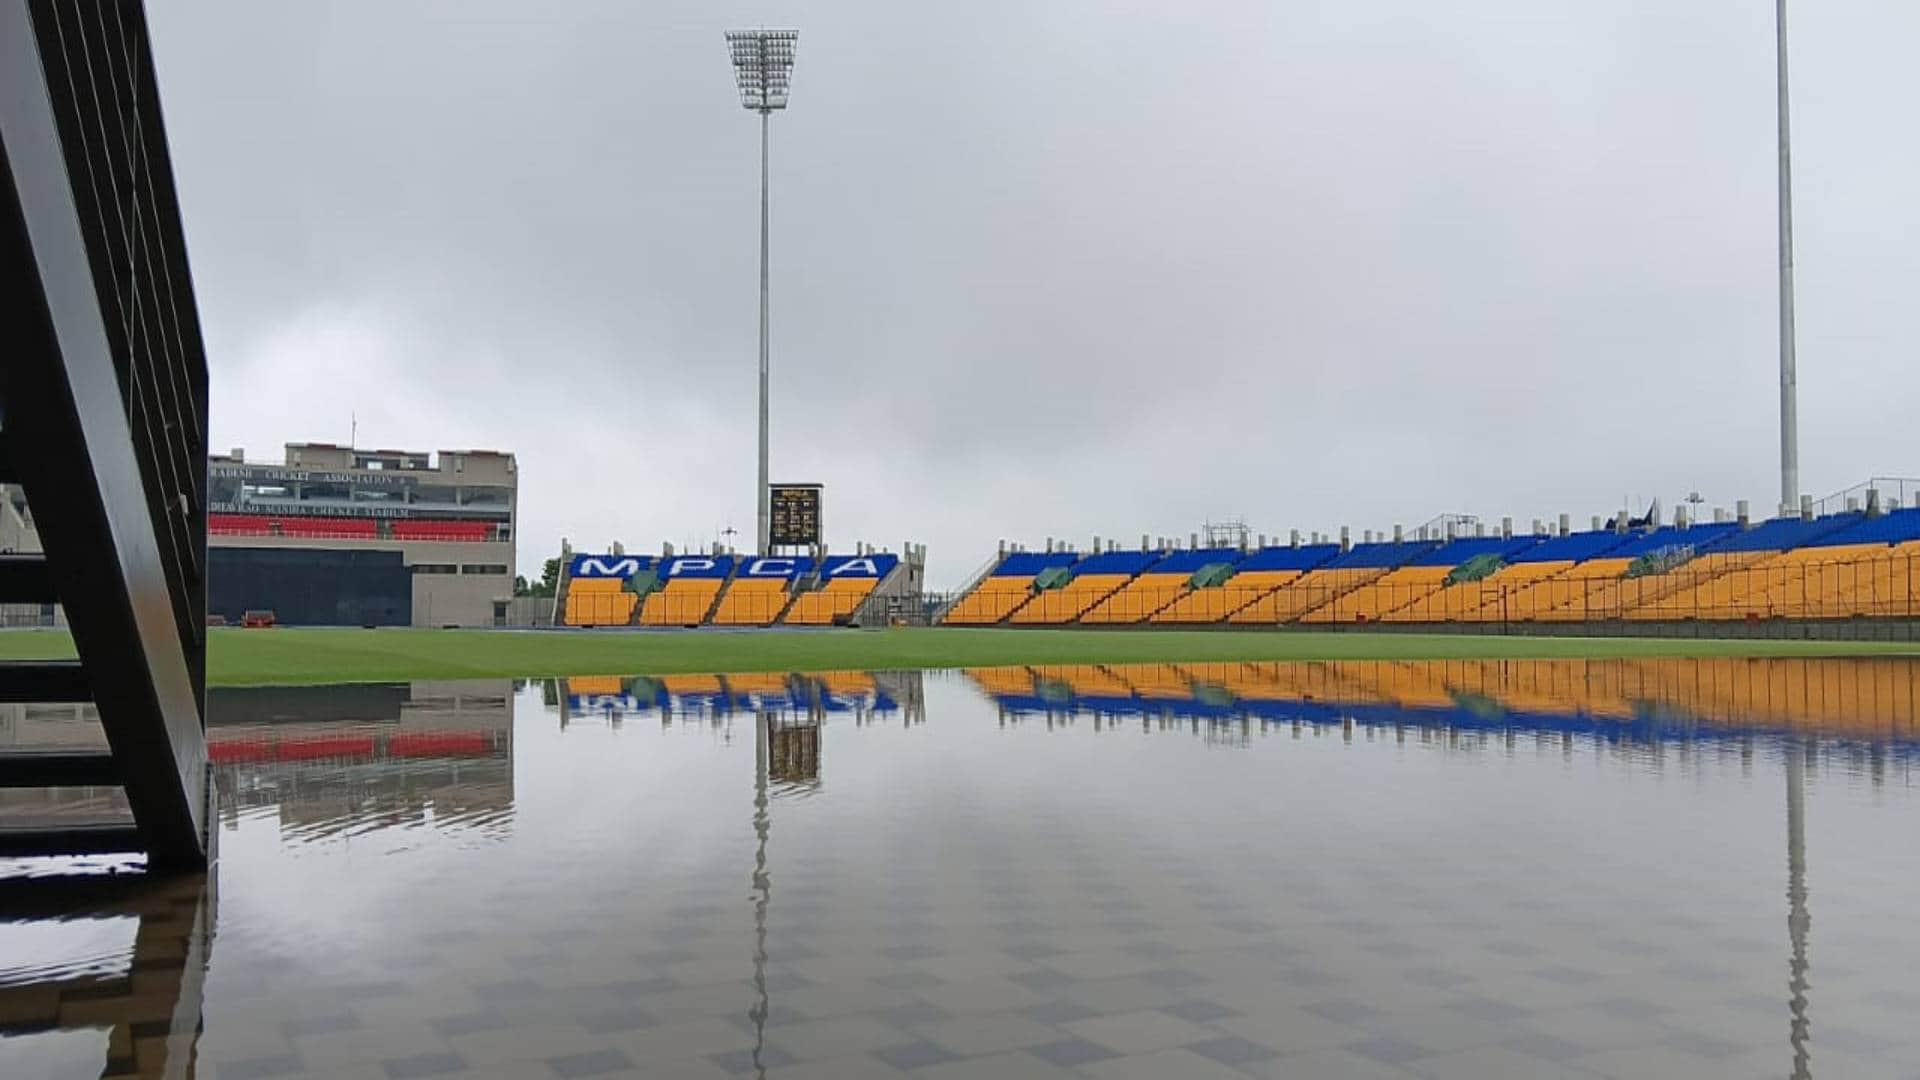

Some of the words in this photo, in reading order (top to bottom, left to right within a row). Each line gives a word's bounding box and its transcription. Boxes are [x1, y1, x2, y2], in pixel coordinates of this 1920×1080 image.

[264, 469, 309, 481] CRICKET
[324, 470, 392, 484] ASSOCIATION
[364, 506, 409, 518] STADIUM
